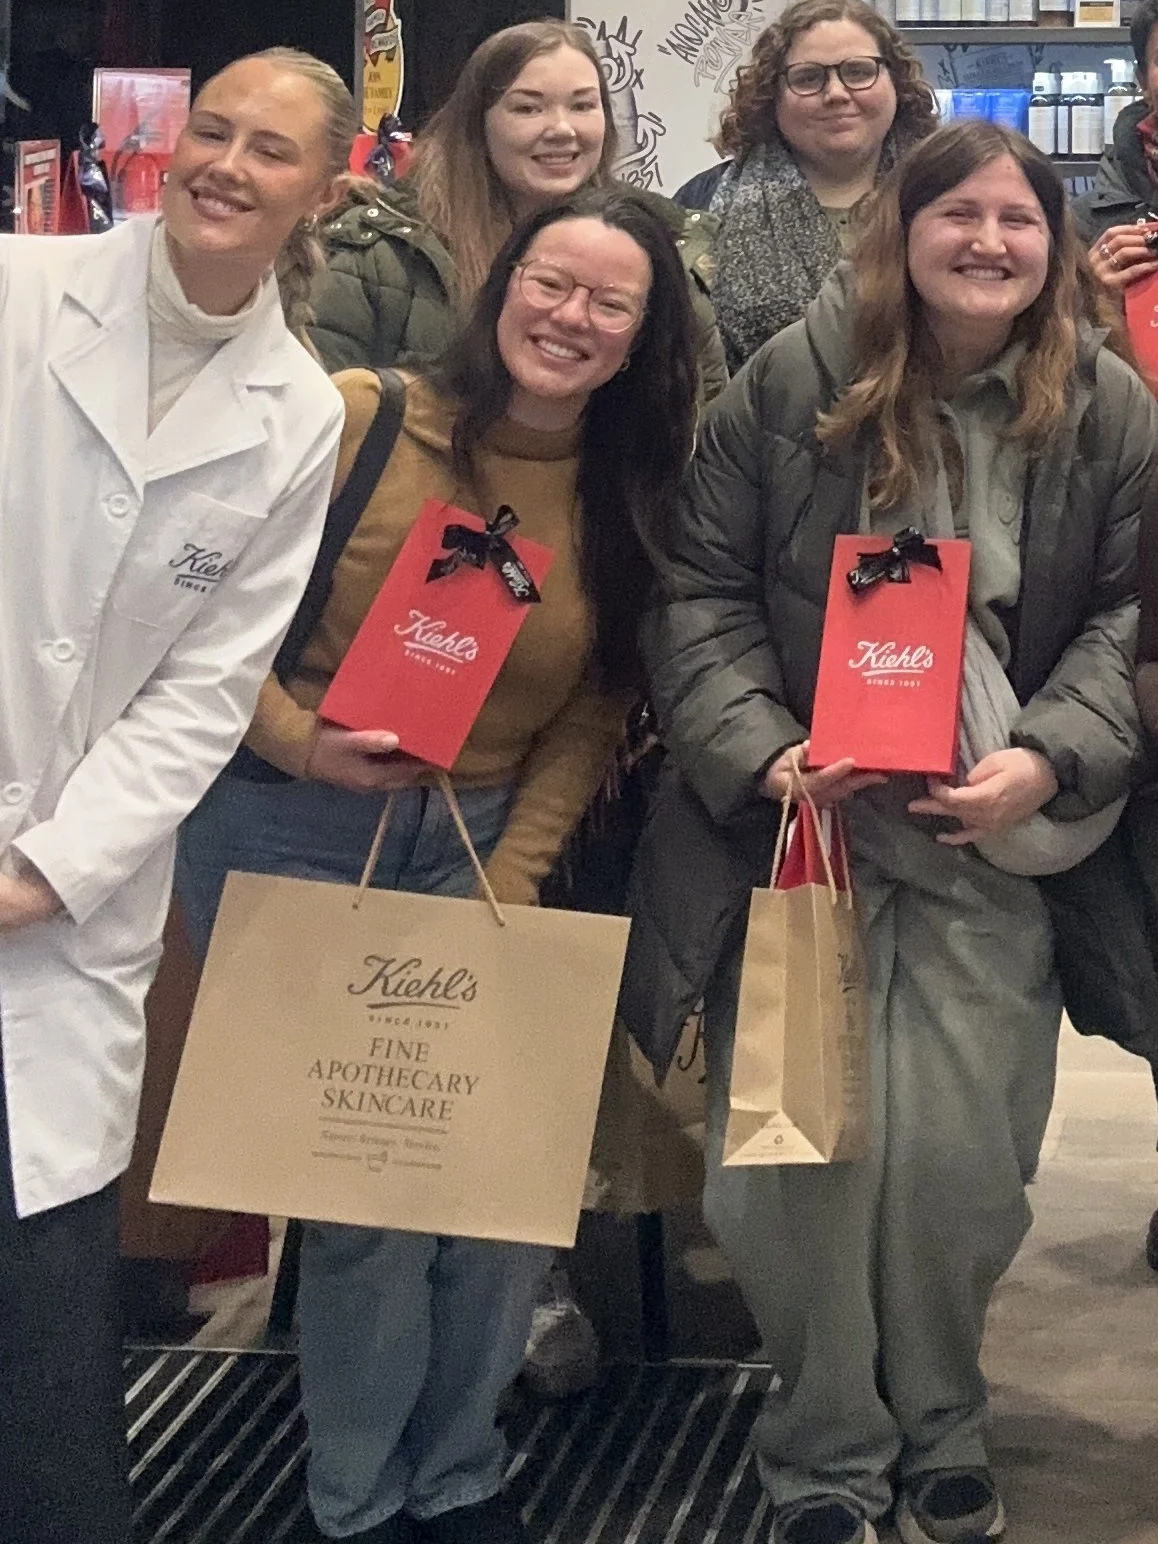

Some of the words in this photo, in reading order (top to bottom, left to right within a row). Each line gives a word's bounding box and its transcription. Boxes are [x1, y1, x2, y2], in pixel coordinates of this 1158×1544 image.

[394, 609, 480, 661] Kiehl's
[849, 641, 934, 669] Kiehl's
[348, 955, 478, 1002] Kiehl's
[369, 1036, 431, 1063] FINE
[307, 1059, 479, 1095] APOTHECARY
[321, 1087, 454, 1121] SKINCARE
